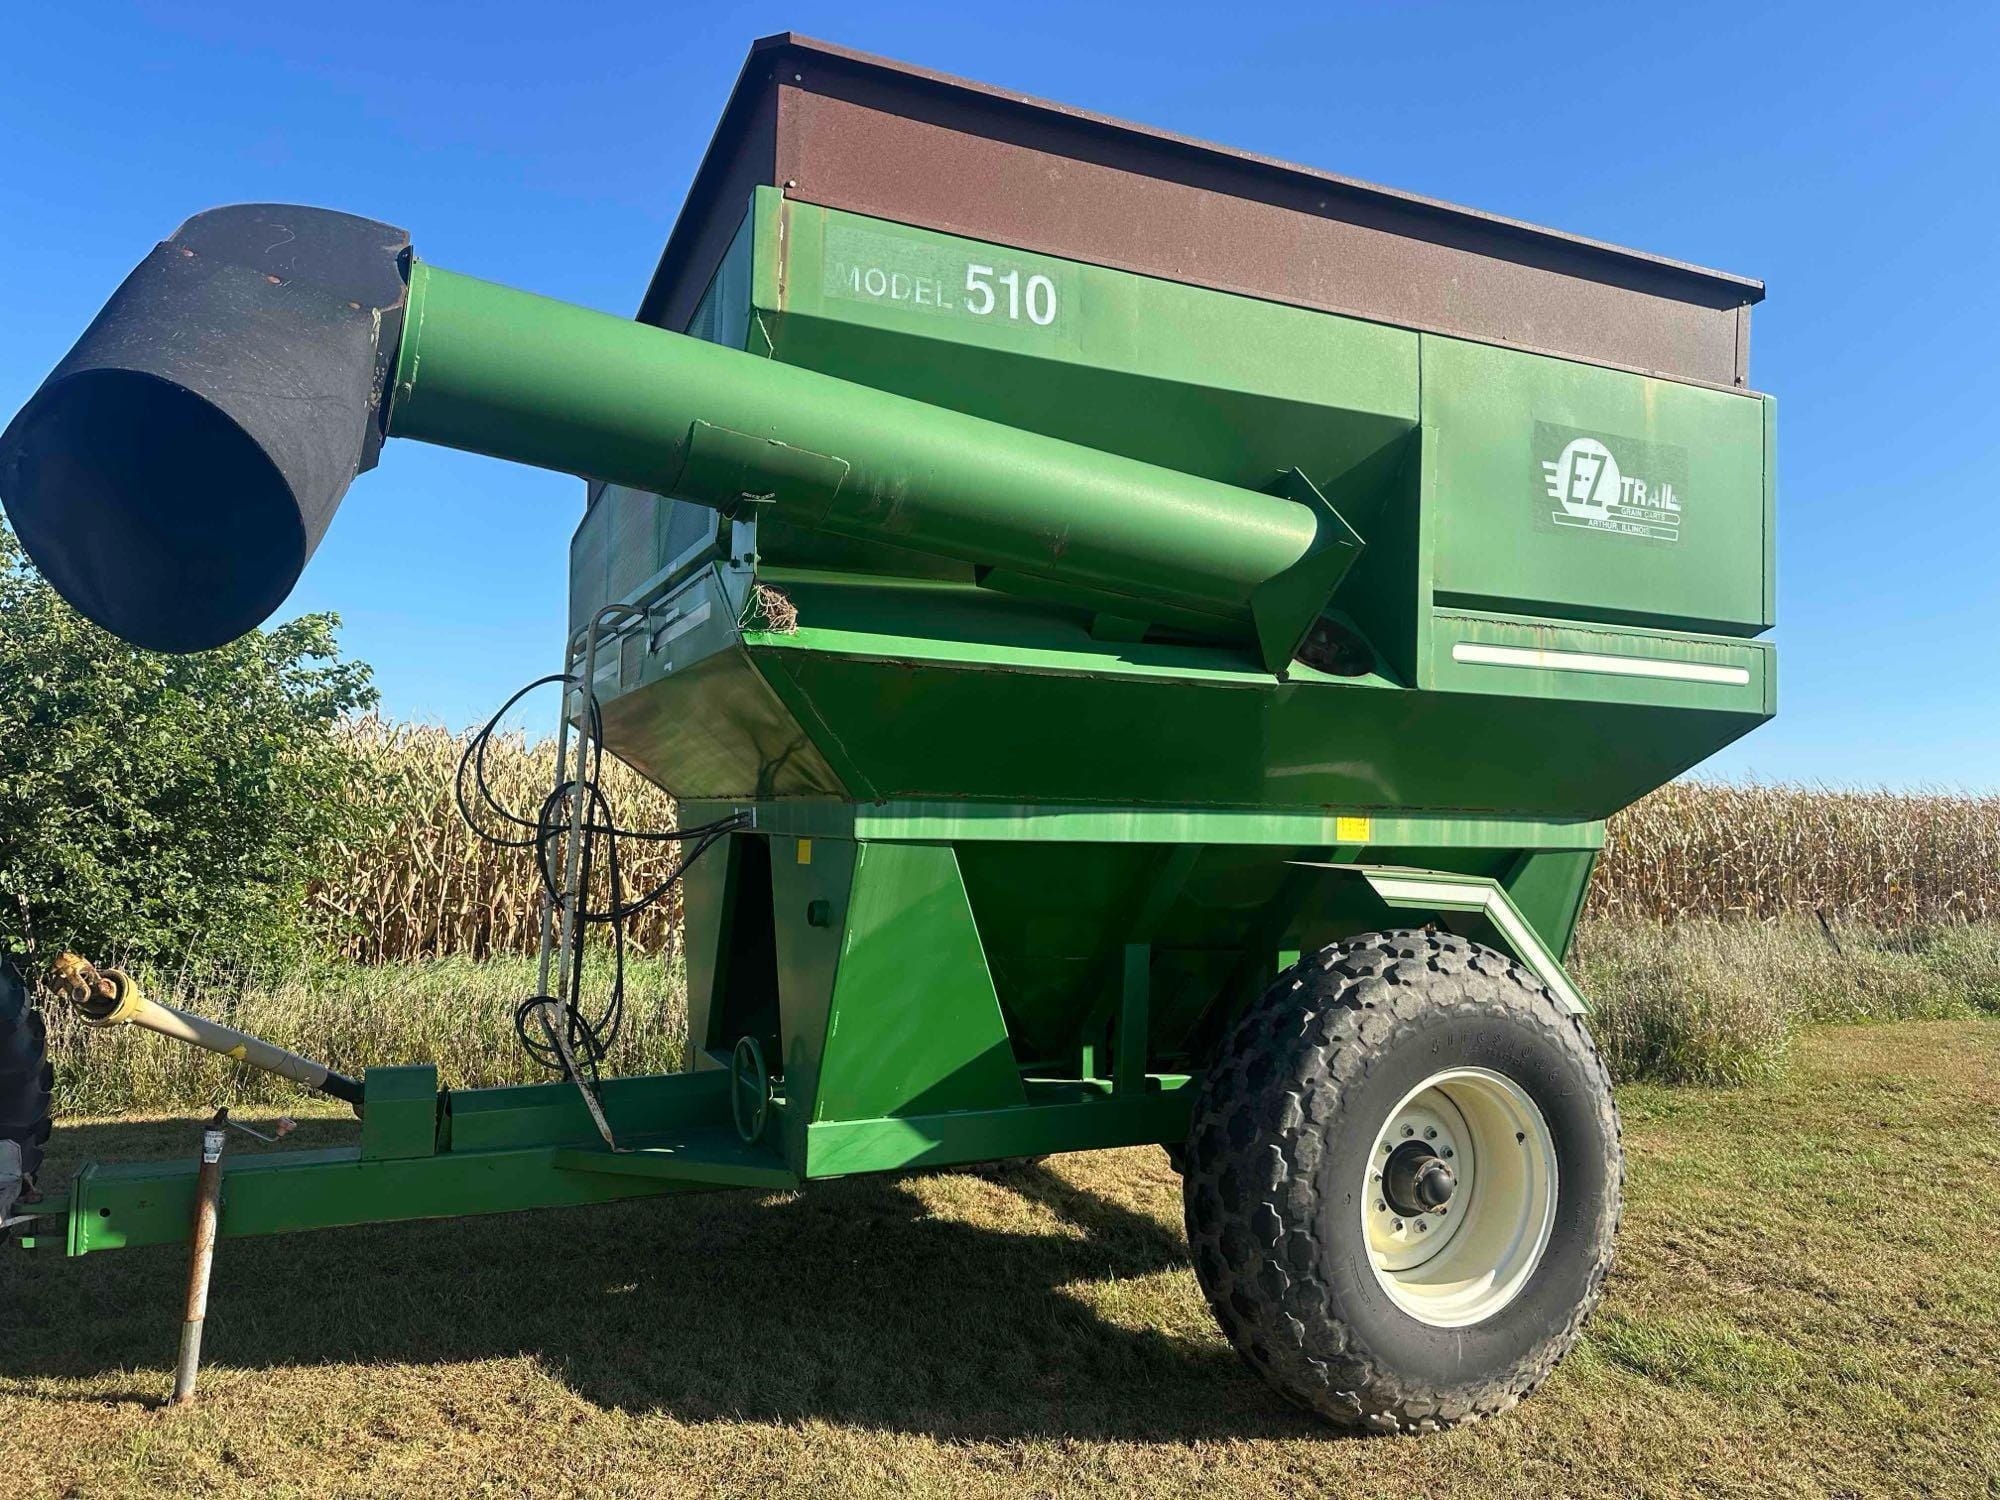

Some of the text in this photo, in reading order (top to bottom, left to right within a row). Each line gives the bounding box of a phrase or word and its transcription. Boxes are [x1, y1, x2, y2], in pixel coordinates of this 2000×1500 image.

[833, 262, 1057, 326] MODEL 510
[1620, 475, 1681, 512] TRAIL
[1621, 508, 1666, 521] GRAIN CARTS
